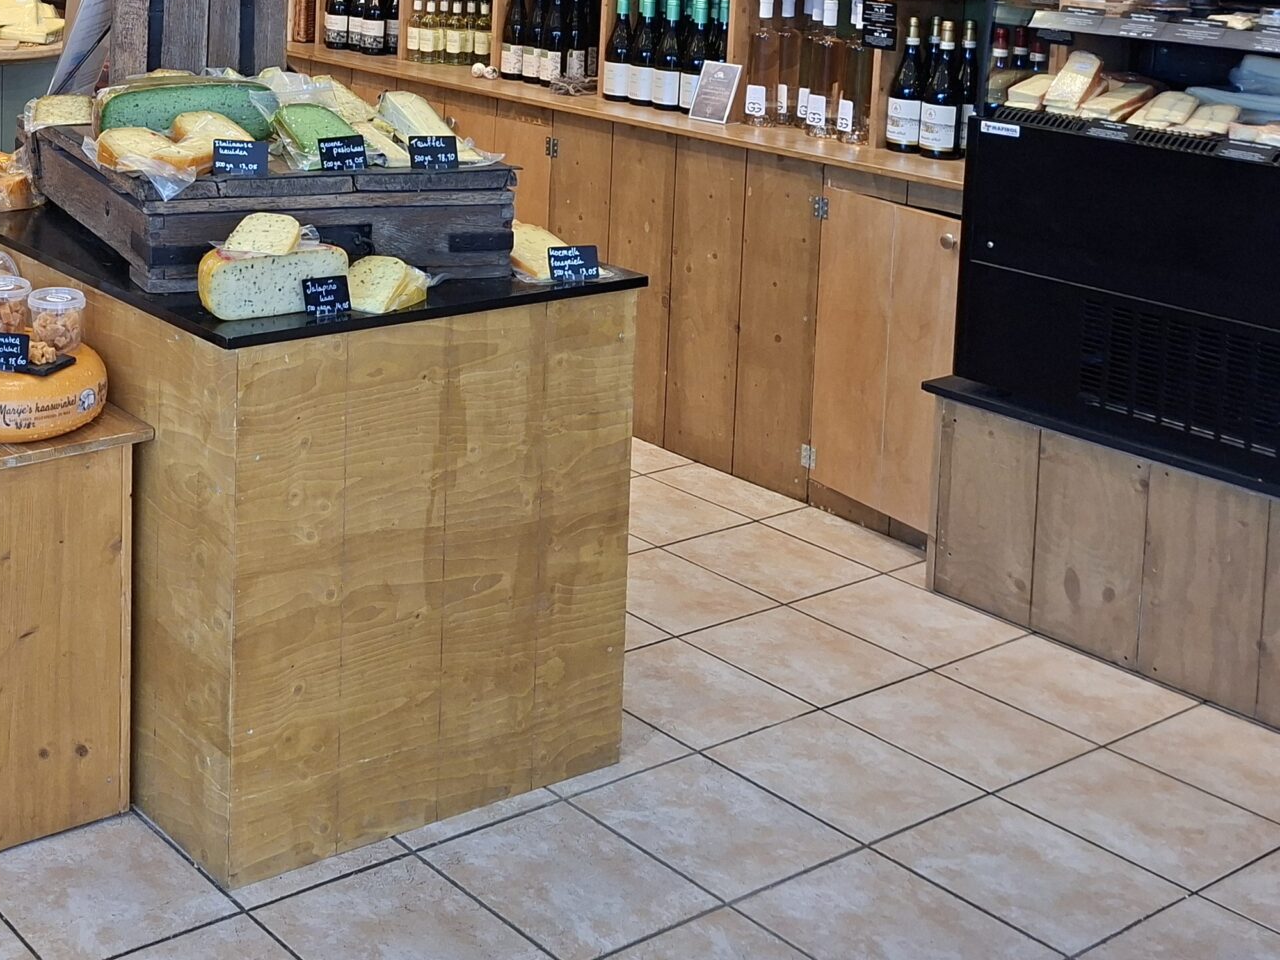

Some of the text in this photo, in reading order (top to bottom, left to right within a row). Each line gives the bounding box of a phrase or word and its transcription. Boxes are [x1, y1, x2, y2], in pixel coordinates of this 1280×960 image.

[214, 140, 253, 148] Italiaanse
[410, 136, 445, 148] Truffel
[345, 156, 364, 166] 13,05
[437, 153, 455, 162] 18,10
[35, 395, 77, 414] kaaswinkel
